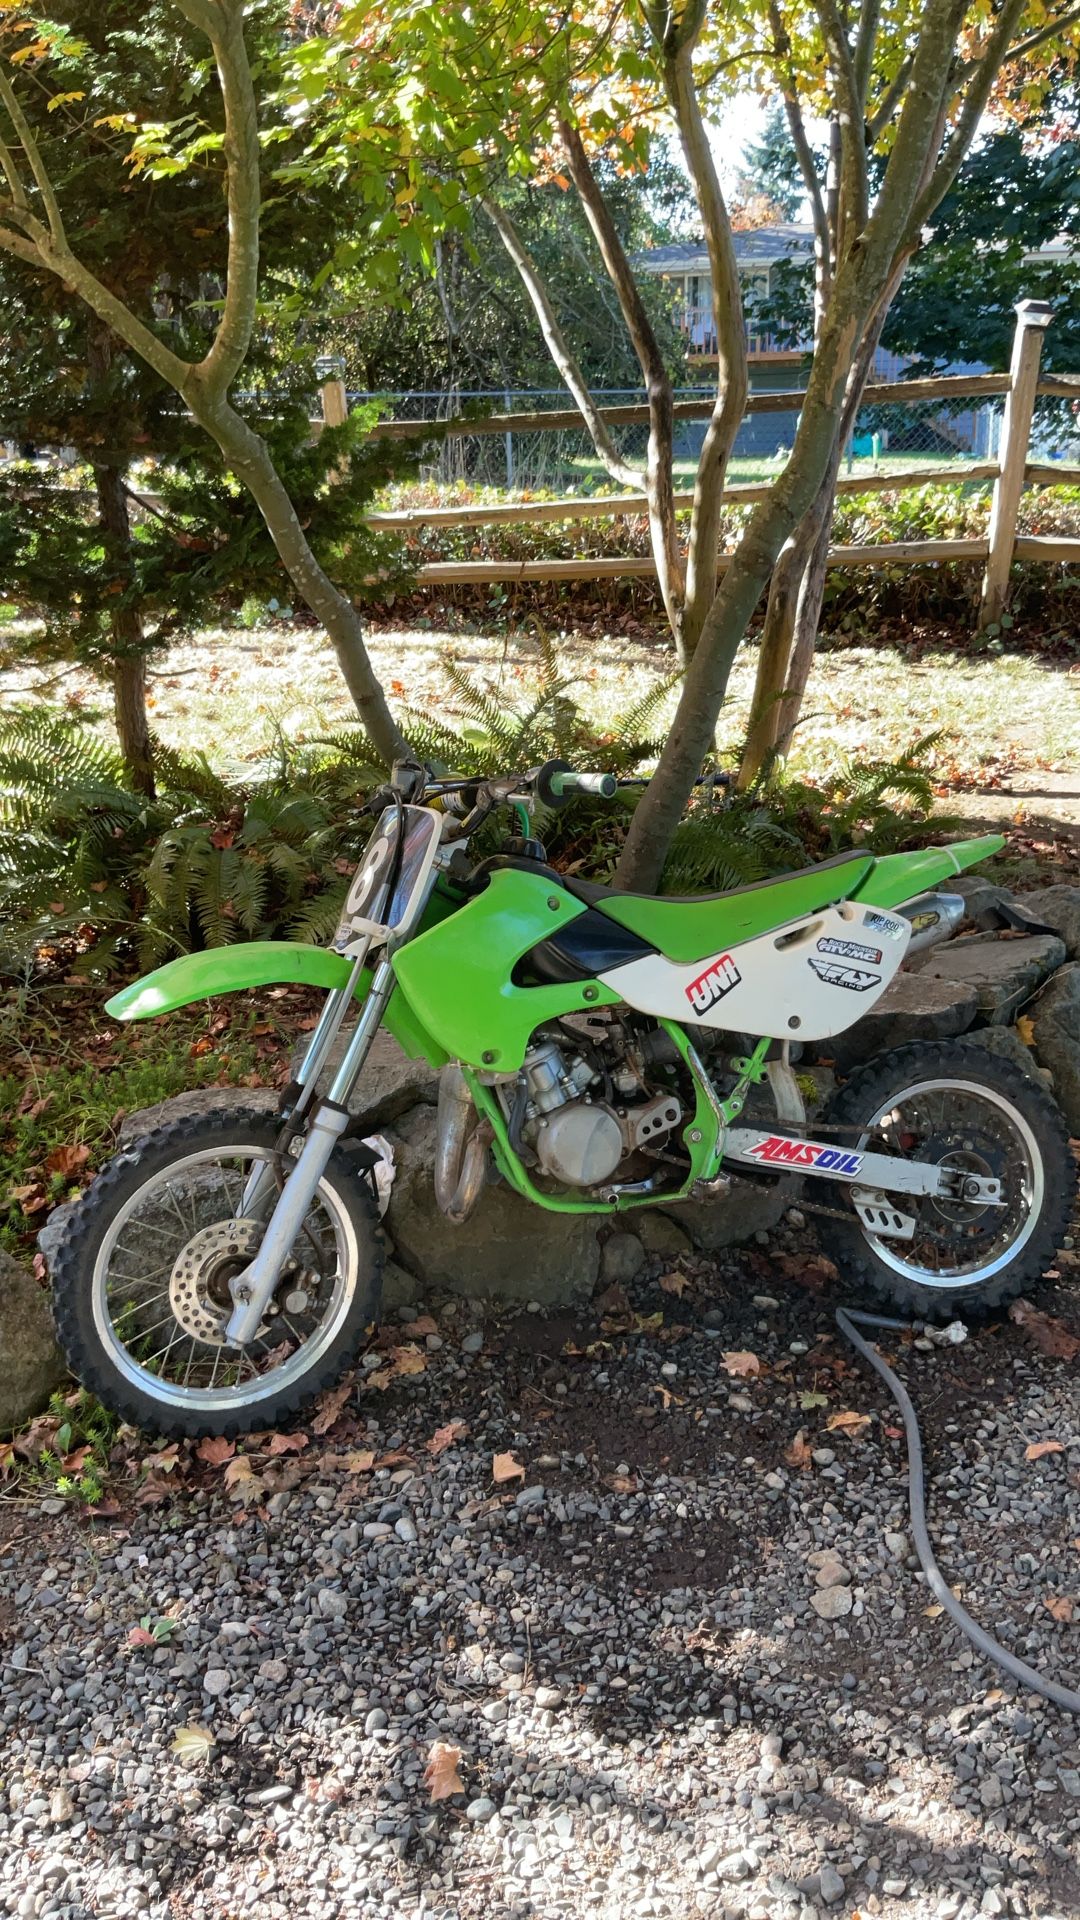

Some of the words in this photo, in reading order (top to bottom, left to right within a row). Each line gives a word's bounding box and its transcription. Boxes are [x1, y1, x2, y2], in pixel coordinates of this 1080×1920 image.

[870, 914, 883, 926] RIP
[690, 958, 739, 1010] UNI
[820, 962, 880, 986] FLY
[822, 976, 863, 990] RACING
[751, 1137, 860, 1173] AMSOIL
